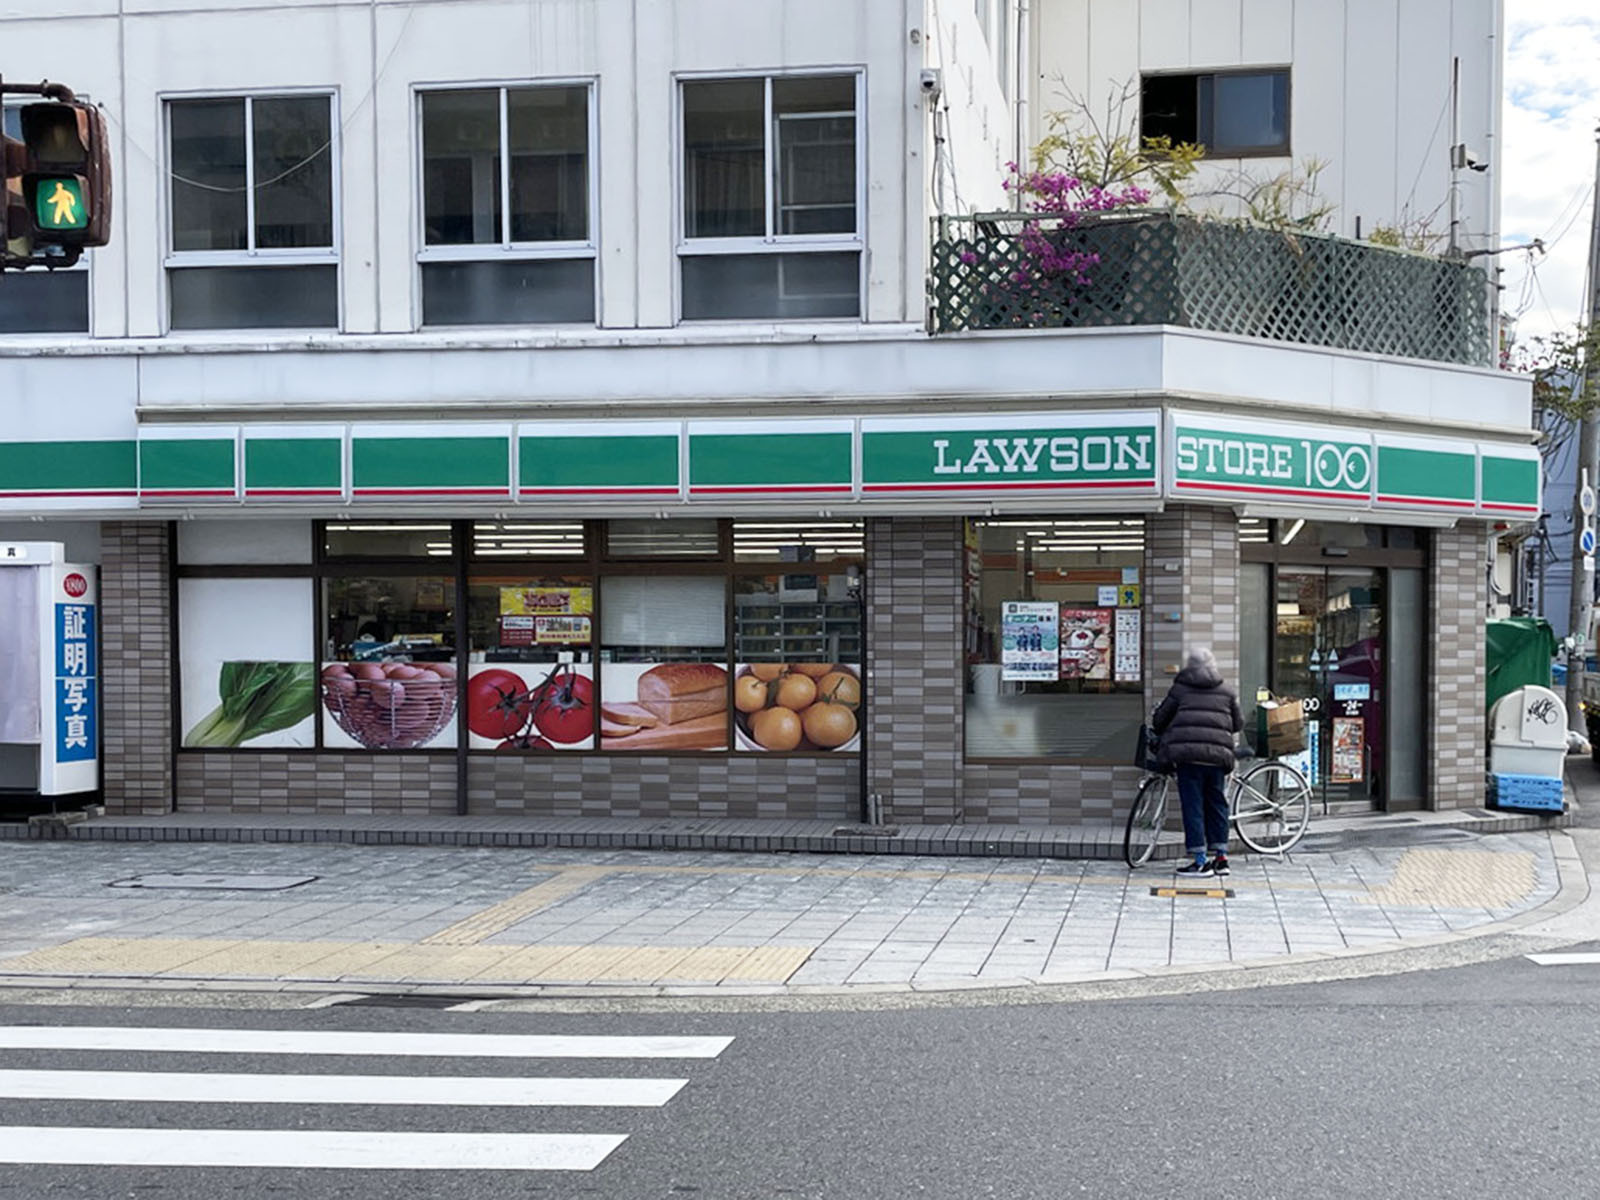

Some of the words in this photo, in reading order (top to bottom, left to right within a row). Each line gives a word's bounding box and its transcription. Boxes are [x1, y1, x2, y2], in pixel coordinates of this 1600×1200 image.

[933, 435, 1152, 474] LAWSON
[1177, 436, 1293, 478] STORE
[1301, 441, 1370, 489] 100
[63, 605, 88, 749] 証明写真
